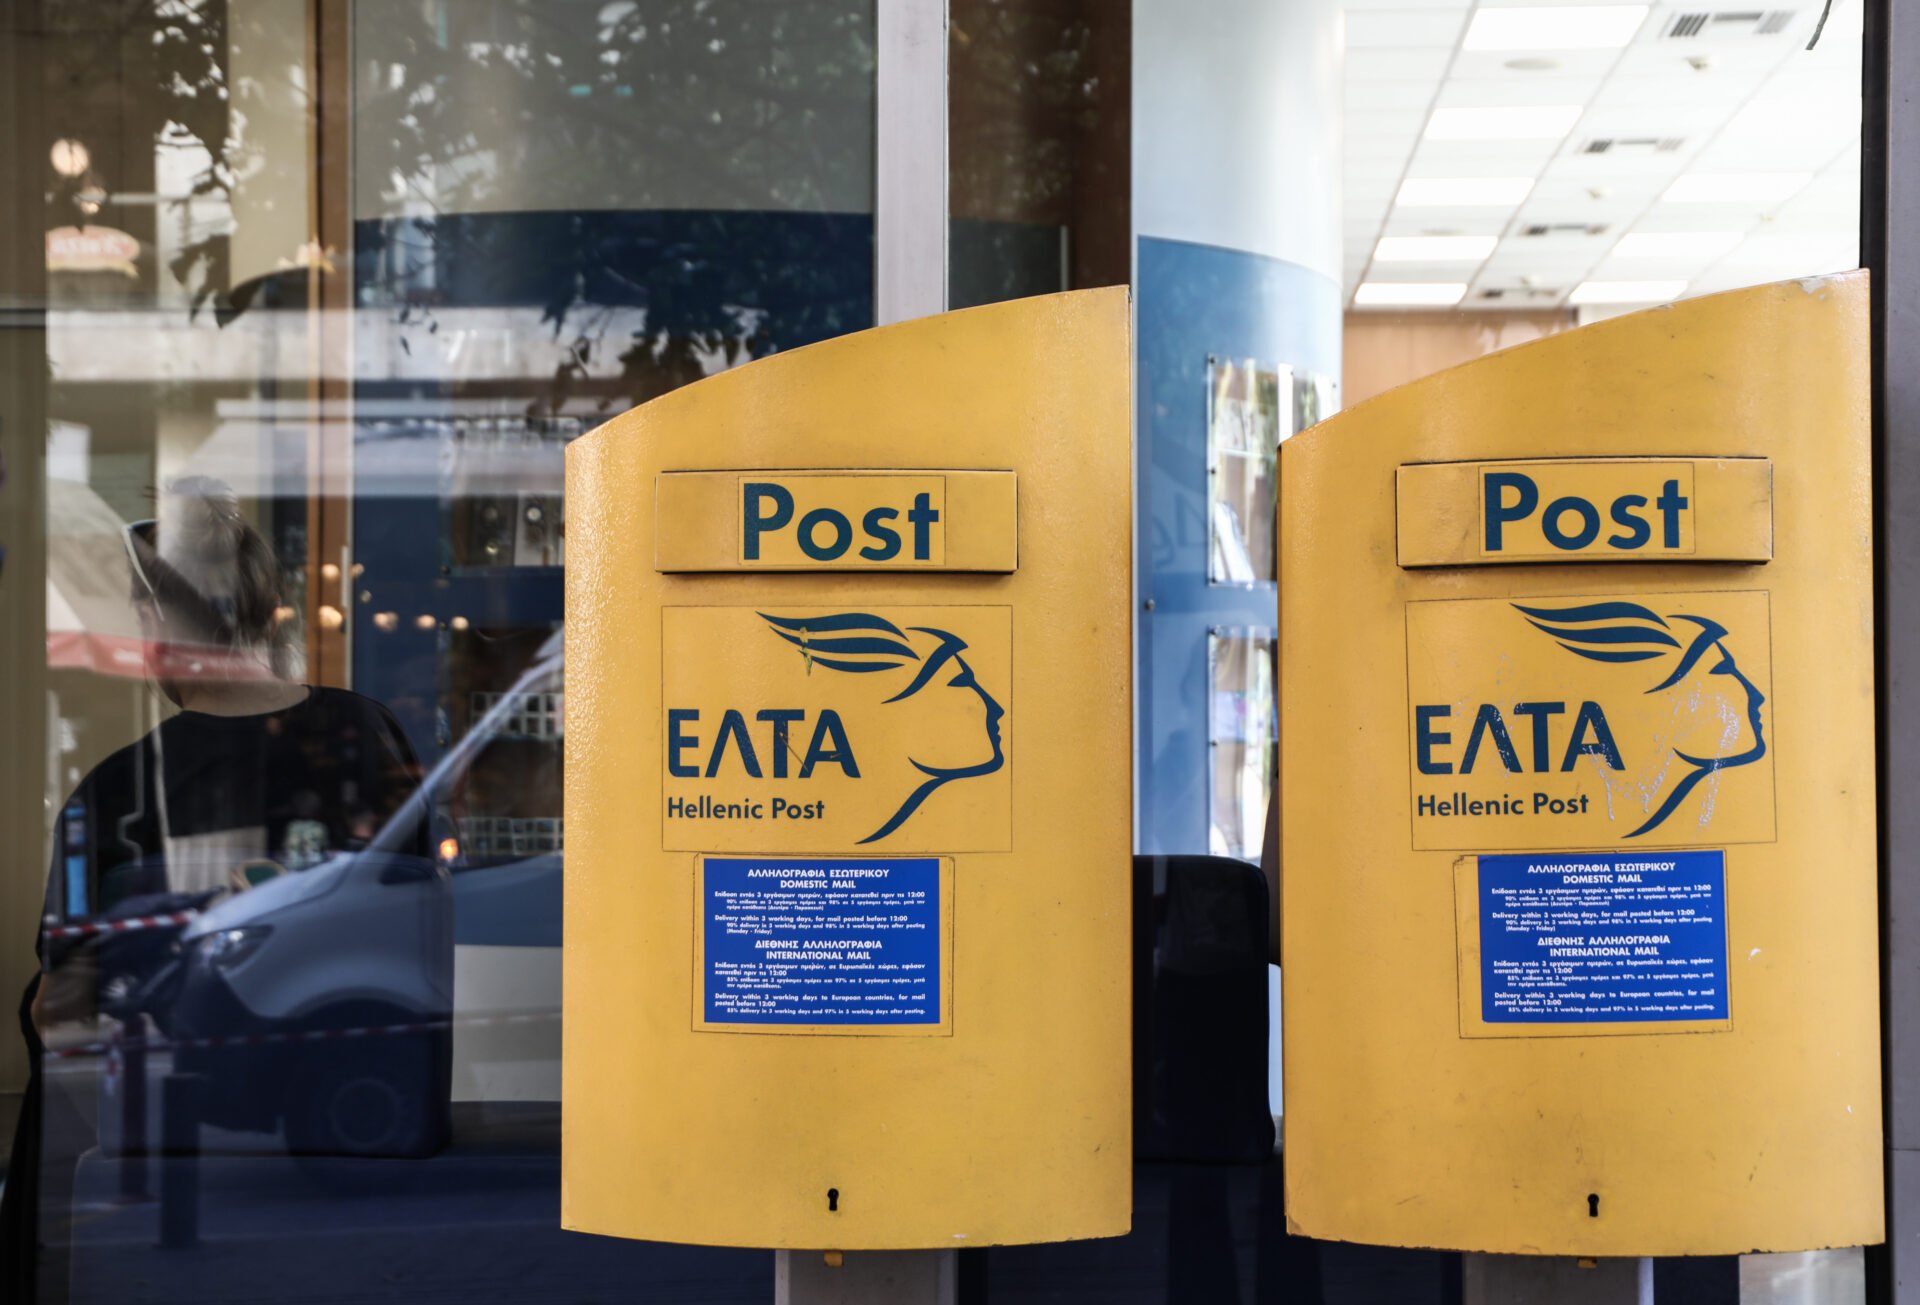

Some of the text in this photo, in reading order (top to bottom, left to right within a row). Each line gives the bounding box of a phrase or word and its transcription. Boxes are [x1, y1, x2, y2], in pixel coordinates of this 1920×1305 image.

[744, 483, 939, 561] Post
[1484, 472, 1688, 552] Post
[668, 709, 861, 778] ΕΛΤΑ
[1415, 701, 1626, 775] ΕΛΤΑ
[668, 796, 825, 819] Hellenic Post
[1418, 792, 1589, 816] Hellenic Post
[1528, 863, 1675, 873] ΑΛΛΗΛΟΓΡΑΦΙΑ ΕΣΩΤΕΡΙΚΟΥ
[1563, 874, 1642, 883] DOMESTIC MAIL
[1538, 936, 1670, 946] ΔΙΕΘΝΗΣ ΑΛΛΗΛΟΓΡΑΦΙΑ
[1550, 947, 1659, 956] INTERNATIONAL MAIL
